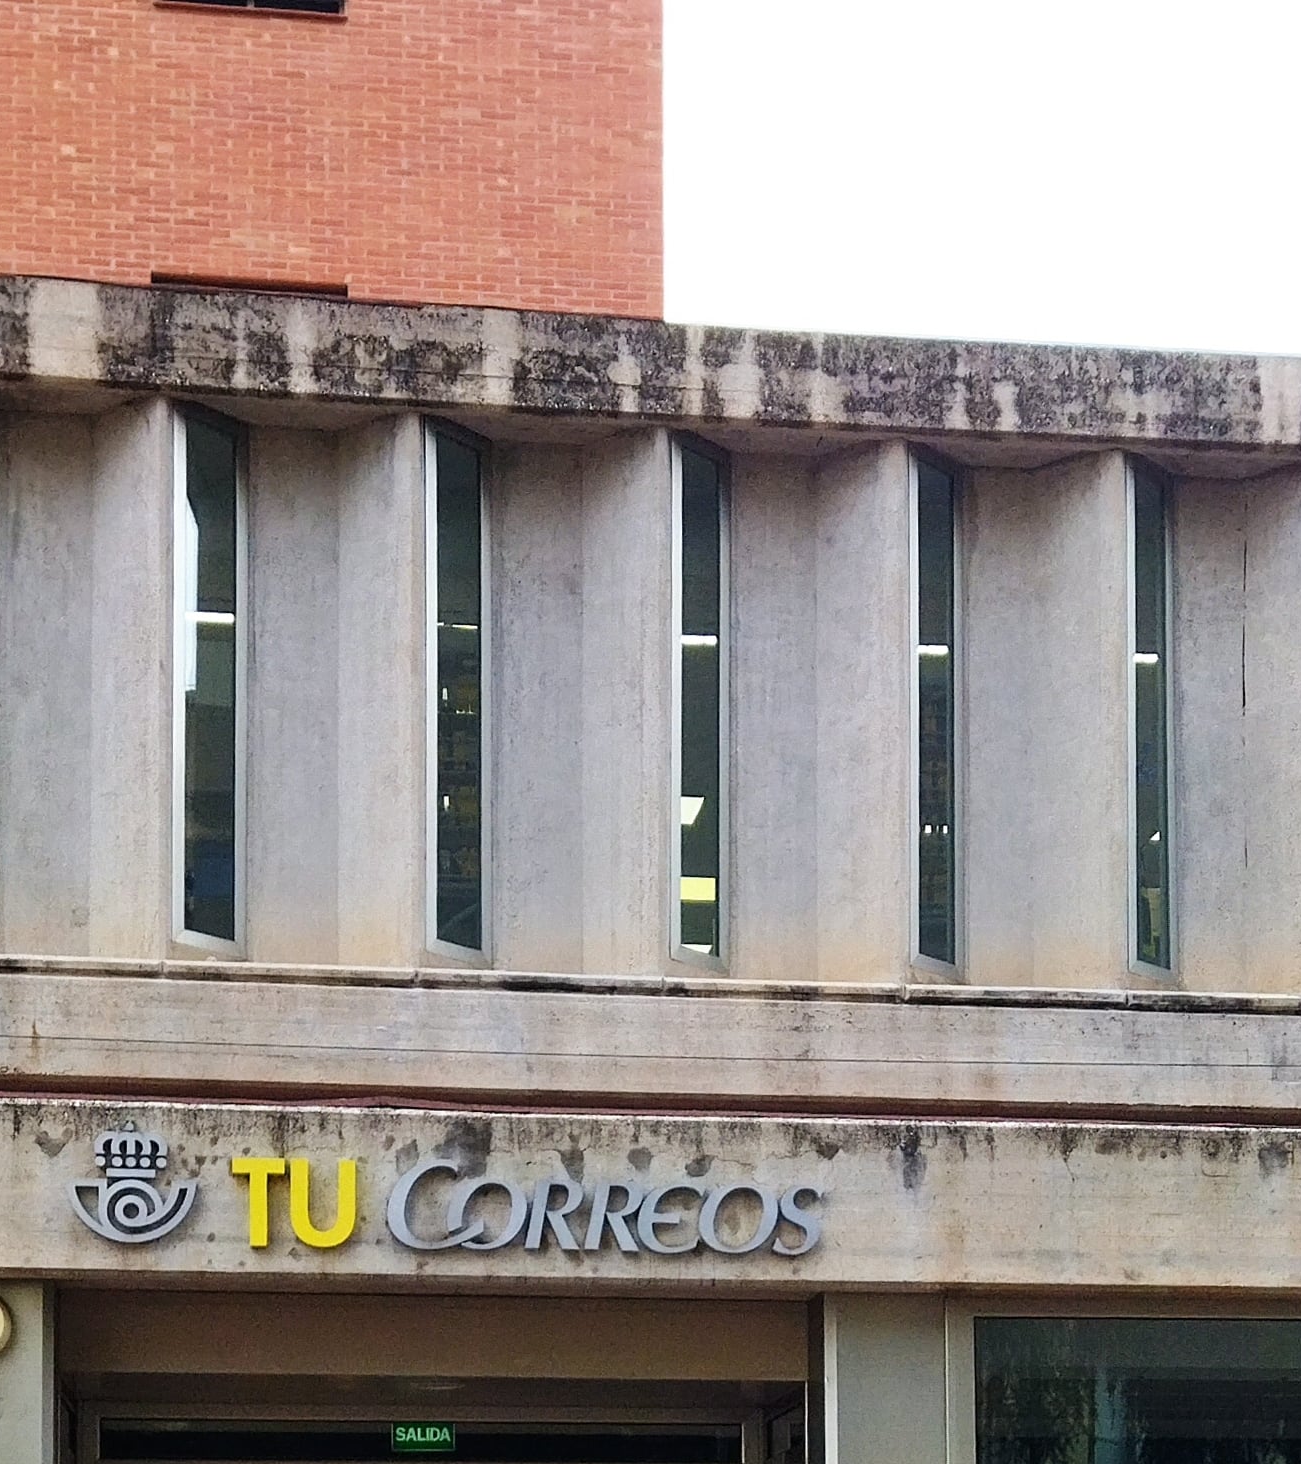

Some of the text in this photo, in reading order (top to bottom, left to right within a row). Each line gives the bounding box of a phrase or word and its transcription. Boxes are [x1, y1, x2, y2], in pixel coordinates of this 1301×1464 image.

[231, 1158, 823, 1256] TU CORREOS
[395, 1426, 451, 1442] SALIDA
